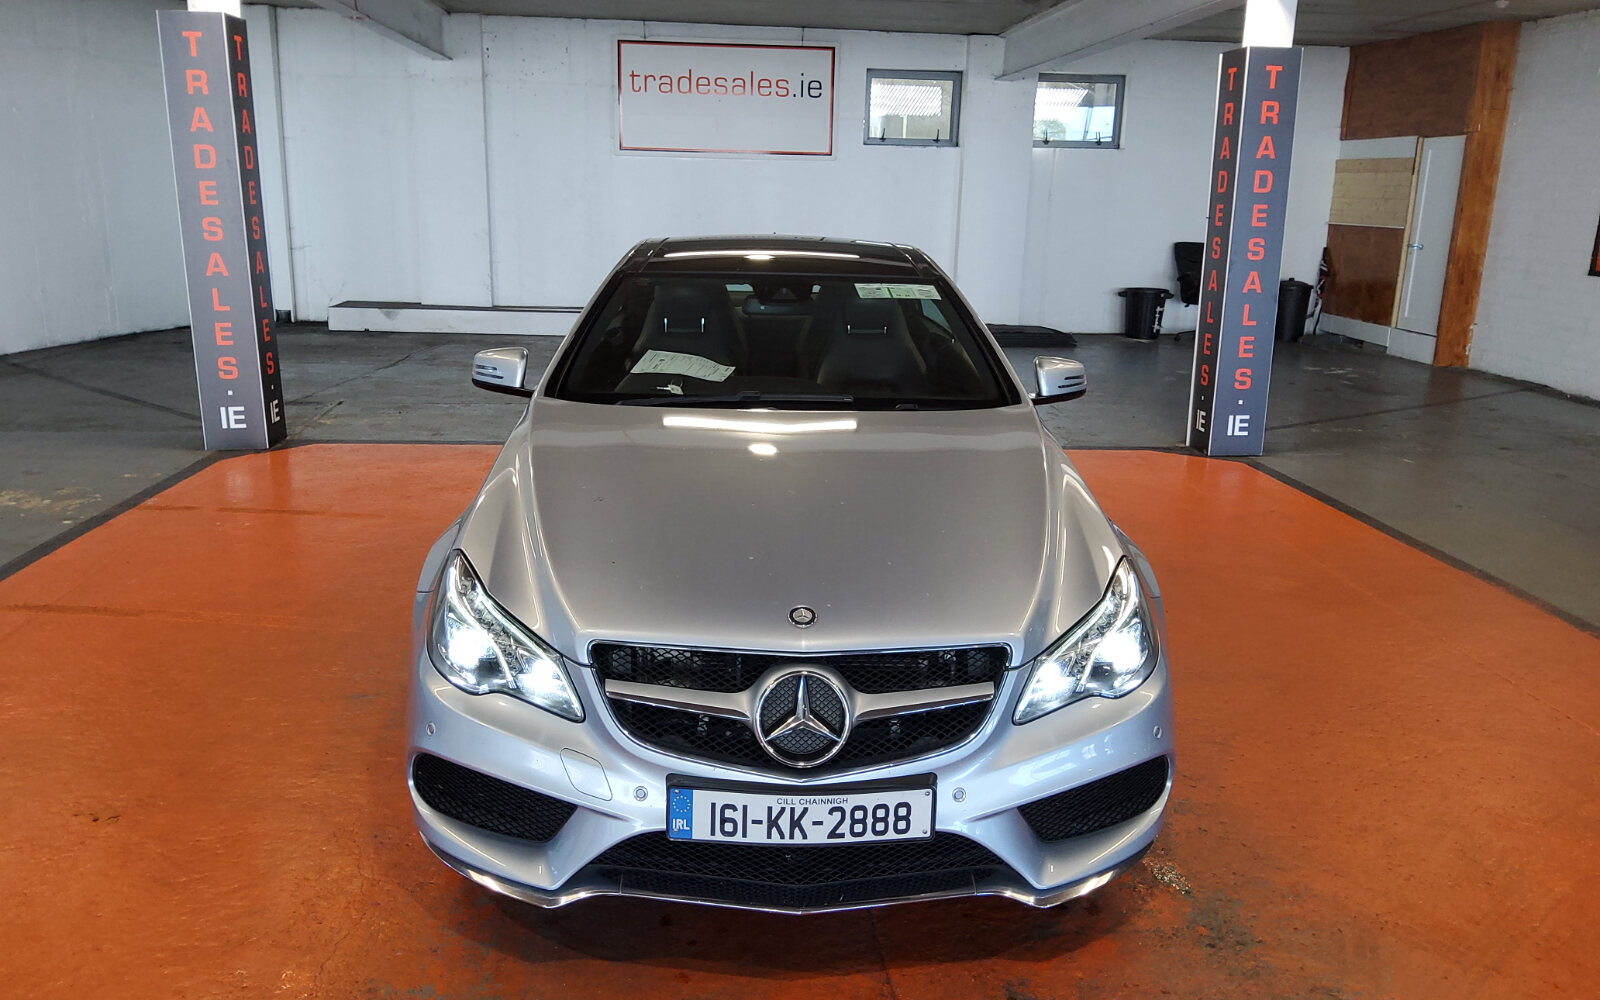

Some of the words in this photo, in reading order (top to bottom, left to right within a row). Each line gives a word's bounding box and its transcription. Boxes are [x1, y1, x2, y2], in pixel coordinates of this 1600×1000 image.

[629, 68, 823, 99] tradesales.ie
[182, 31, 247, 429] TRADESALES.IE
[1226, 65, 1283, 436] TRADESALES.IE
[776, 797, 796, 806] CILL
[799, 797, 849, 806] CHAINNIGH
[672, 818, 690, 831] IRL
[710, 801, 912, 840] 161-KK-2888
